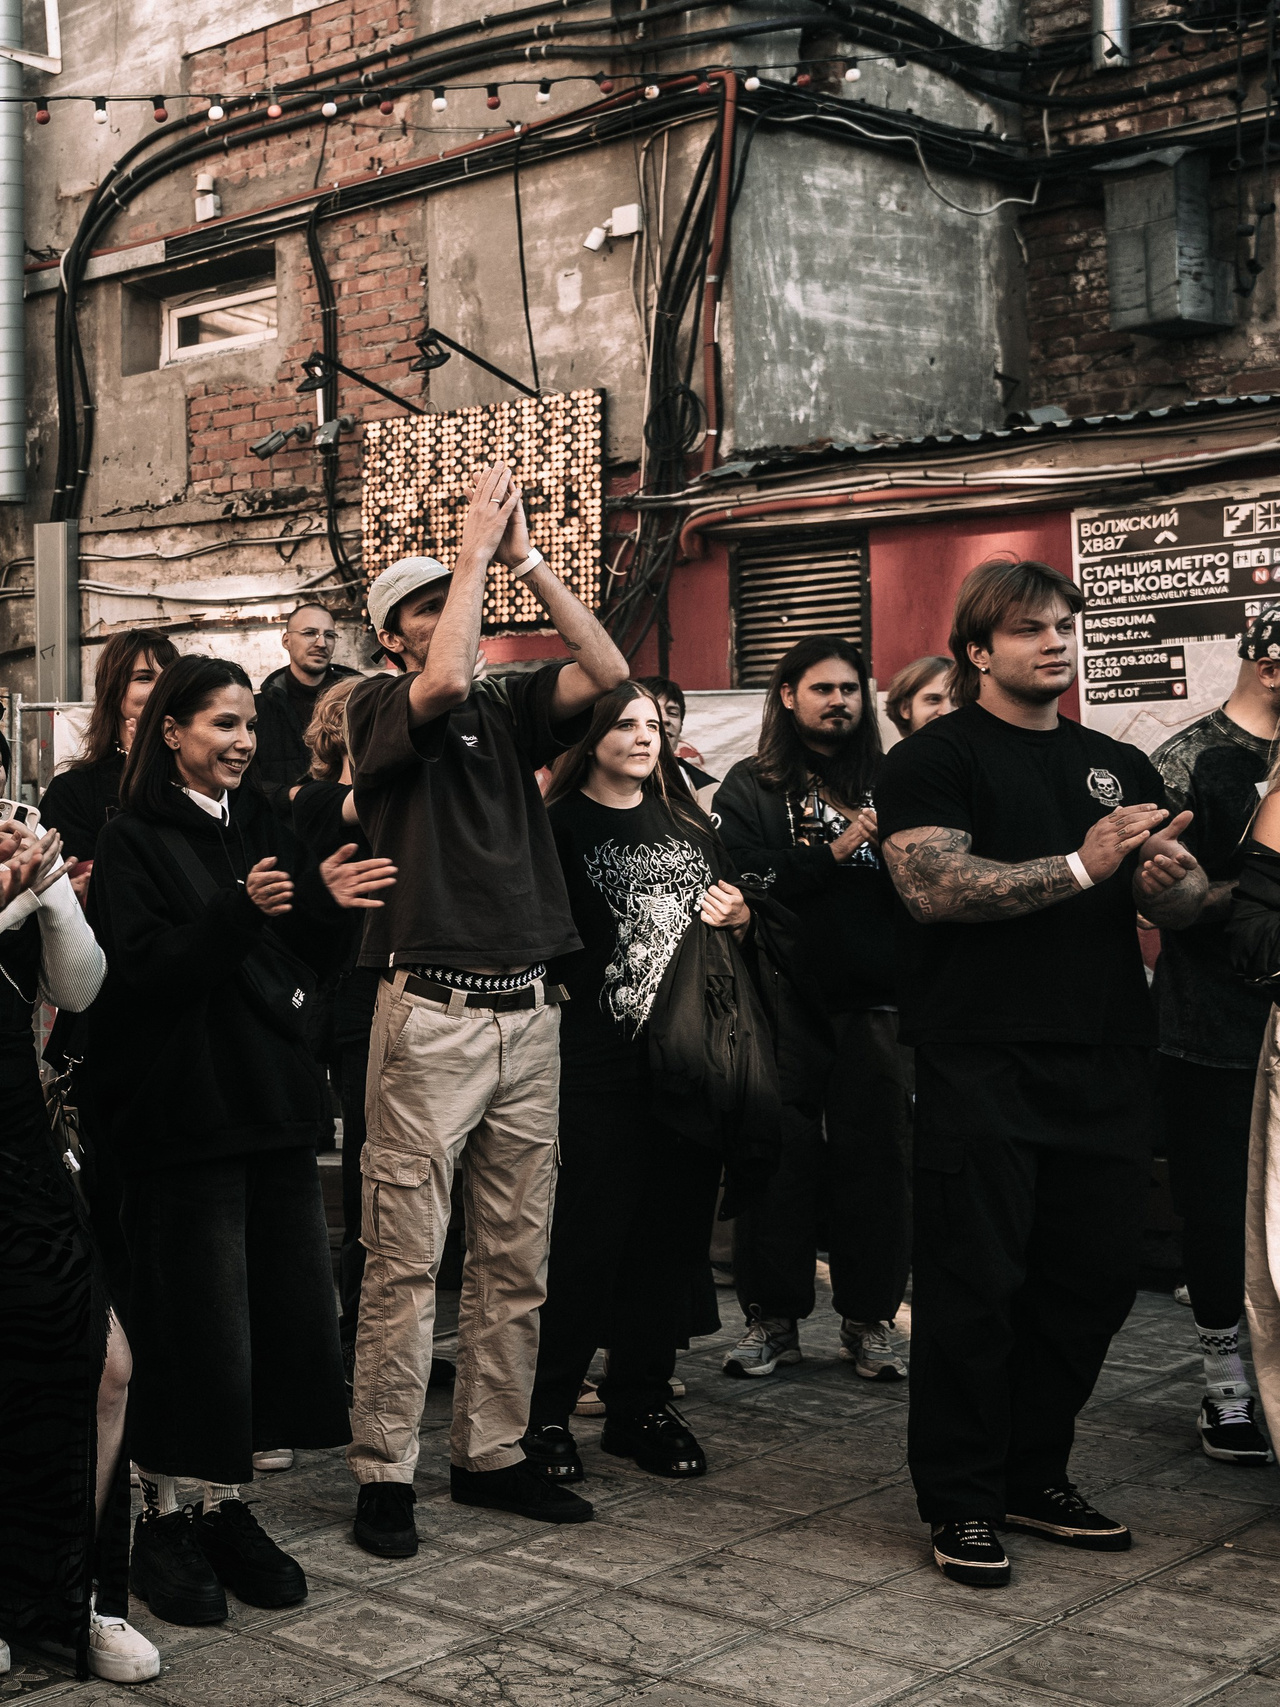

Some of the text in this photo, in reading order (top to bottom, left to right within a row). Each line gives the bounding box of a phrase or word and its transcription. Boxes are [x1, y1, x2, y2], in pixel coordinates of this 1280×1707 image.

[1080, 507, 1179, 537] ВОЛЖСКИЙ
[1082, 552, 1229, 581] СТАНЦИЯ МЕТРО
[1083, 568, 1230, 597] ГОРЬКОВСКАЯ
[1255, 571, 1267, 581] N
[1112, 595, 1127, 605] ME
[1189, 585, 1229, 597] SILYAVA
[1084, 613, 1156, 630] BASSDUMA
[1087, 667, 1122, 679] 22:00
[1088, 688, 1117, 701] Клуб
[1118, 686, 1141, 699] LOT
